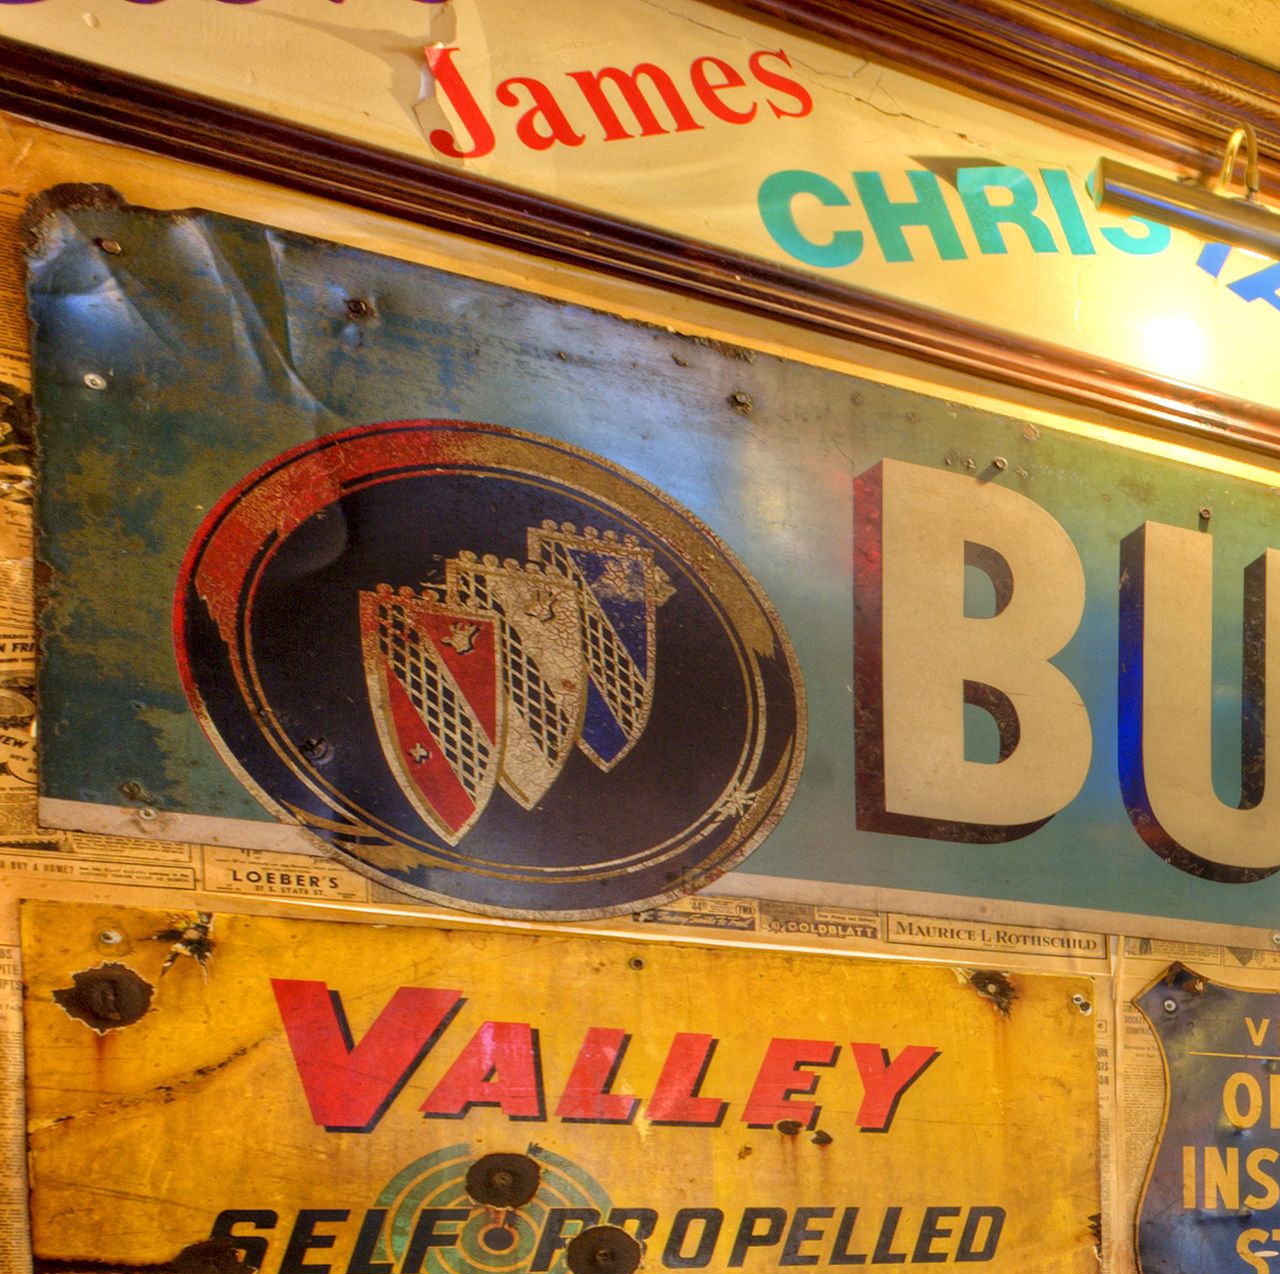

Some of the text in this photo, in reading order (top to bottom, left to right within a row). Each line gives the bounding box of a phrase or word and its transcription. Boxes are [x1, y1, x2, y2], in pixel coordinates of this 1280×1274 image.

[425, 44, 814, 160] James
[231, 869, 340, 889] LOEBER'S
[895, 921, 976, 943] MAURICE
[996, 929, 1098, 951] ROTHSCHILD
[270, 977, 943, 1134] VALLEY
